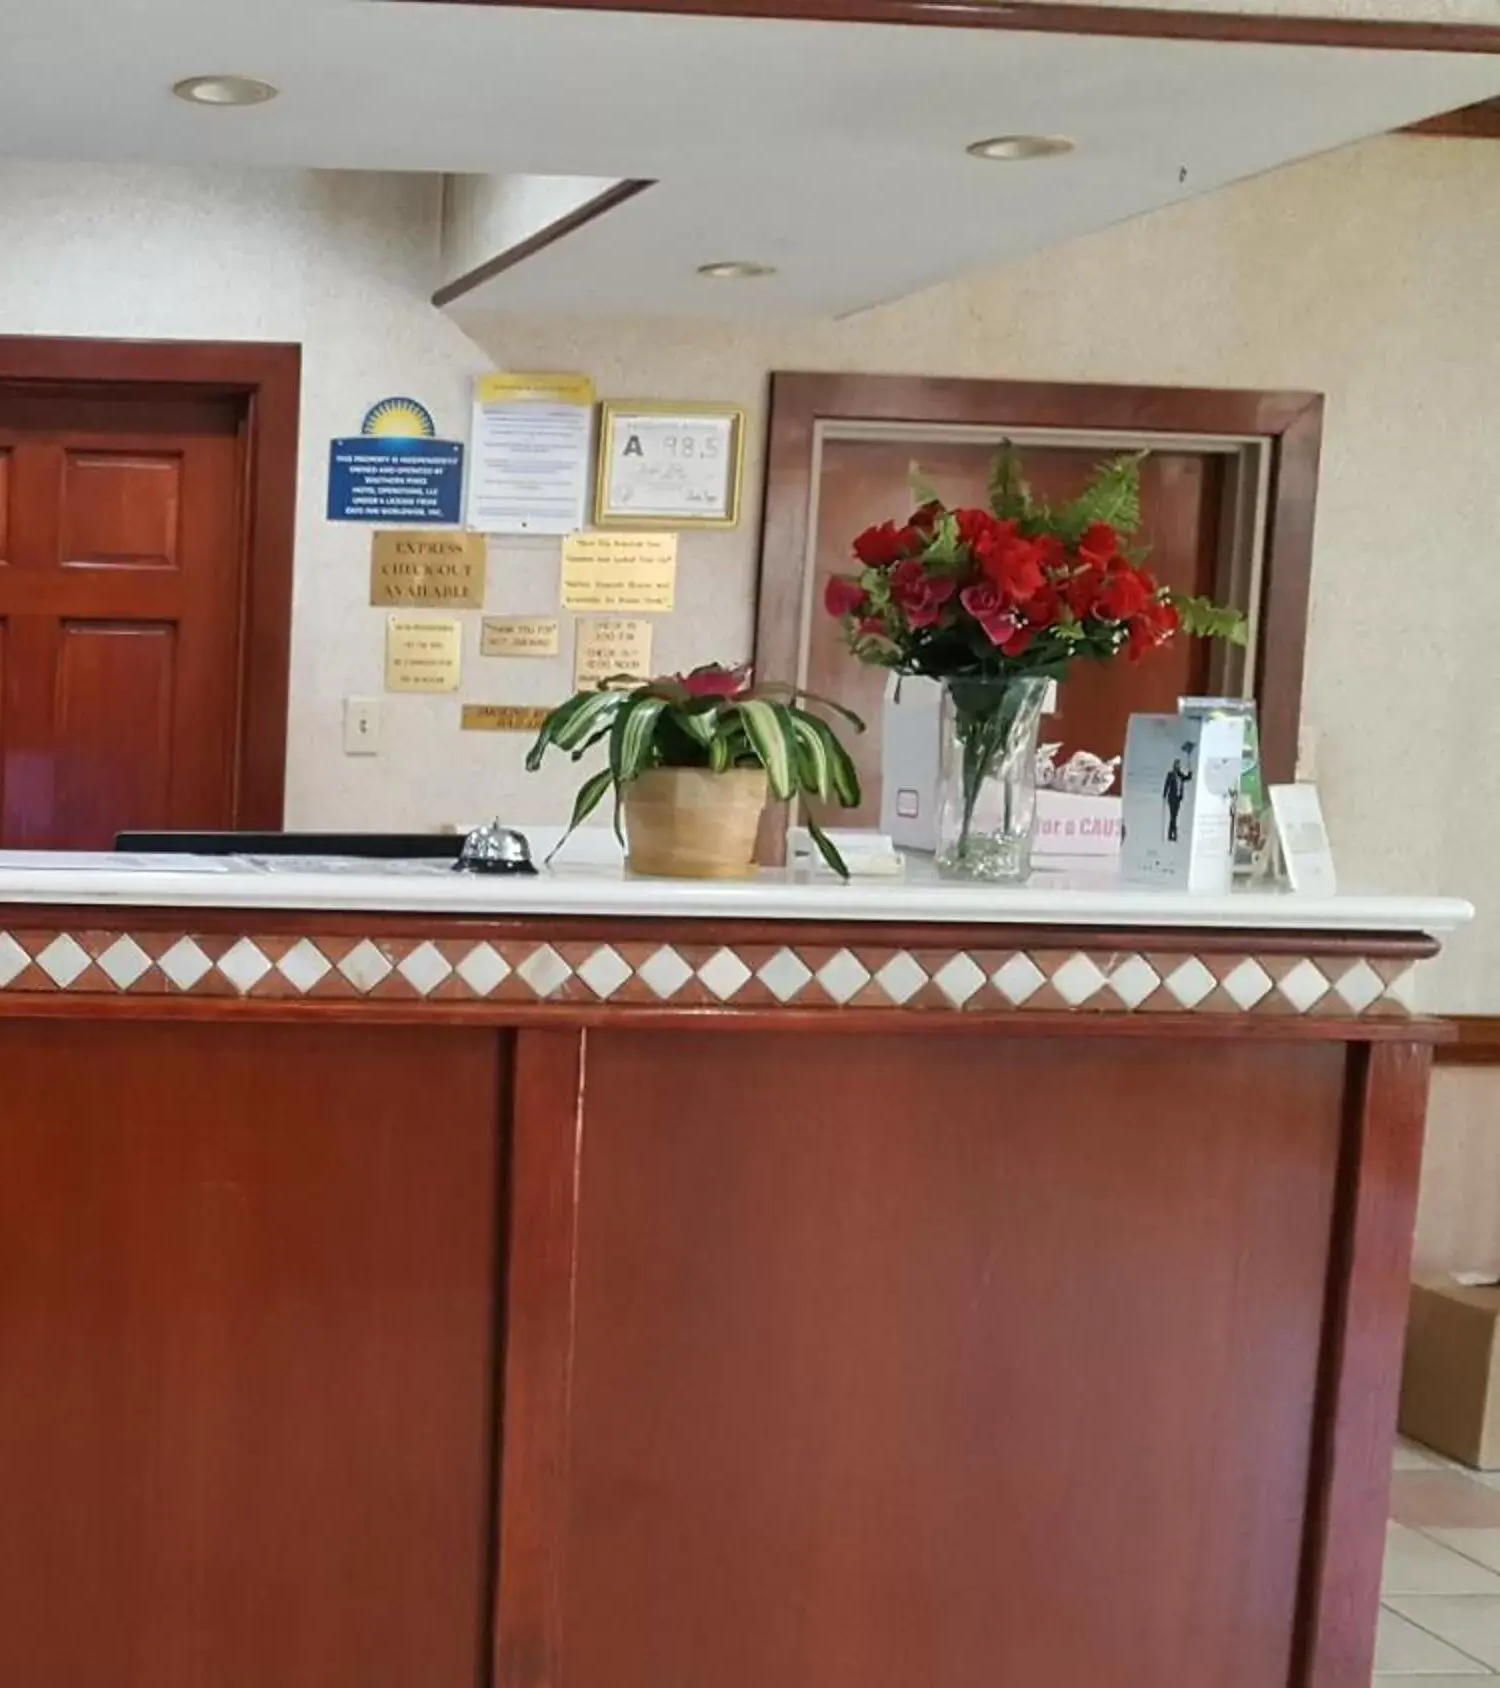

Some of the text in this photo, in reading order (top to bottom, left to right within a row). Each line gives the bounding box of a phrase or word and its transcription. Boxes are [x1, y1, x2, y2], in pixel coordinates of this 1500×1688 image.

[622, 434, 644, 457] A
[354, 455, 390, 465] PROPERTY
[400, 456, 459, 466] INDEPENDENTLY
[349, 465, 378, 475] OWNED
[379, 466, 394, 475] AND
[394, 466, 433, 476] OPERATED
[395, 541, 463, 555] EXPRESS
[384, 583, 470, 600] AVAILABLE
